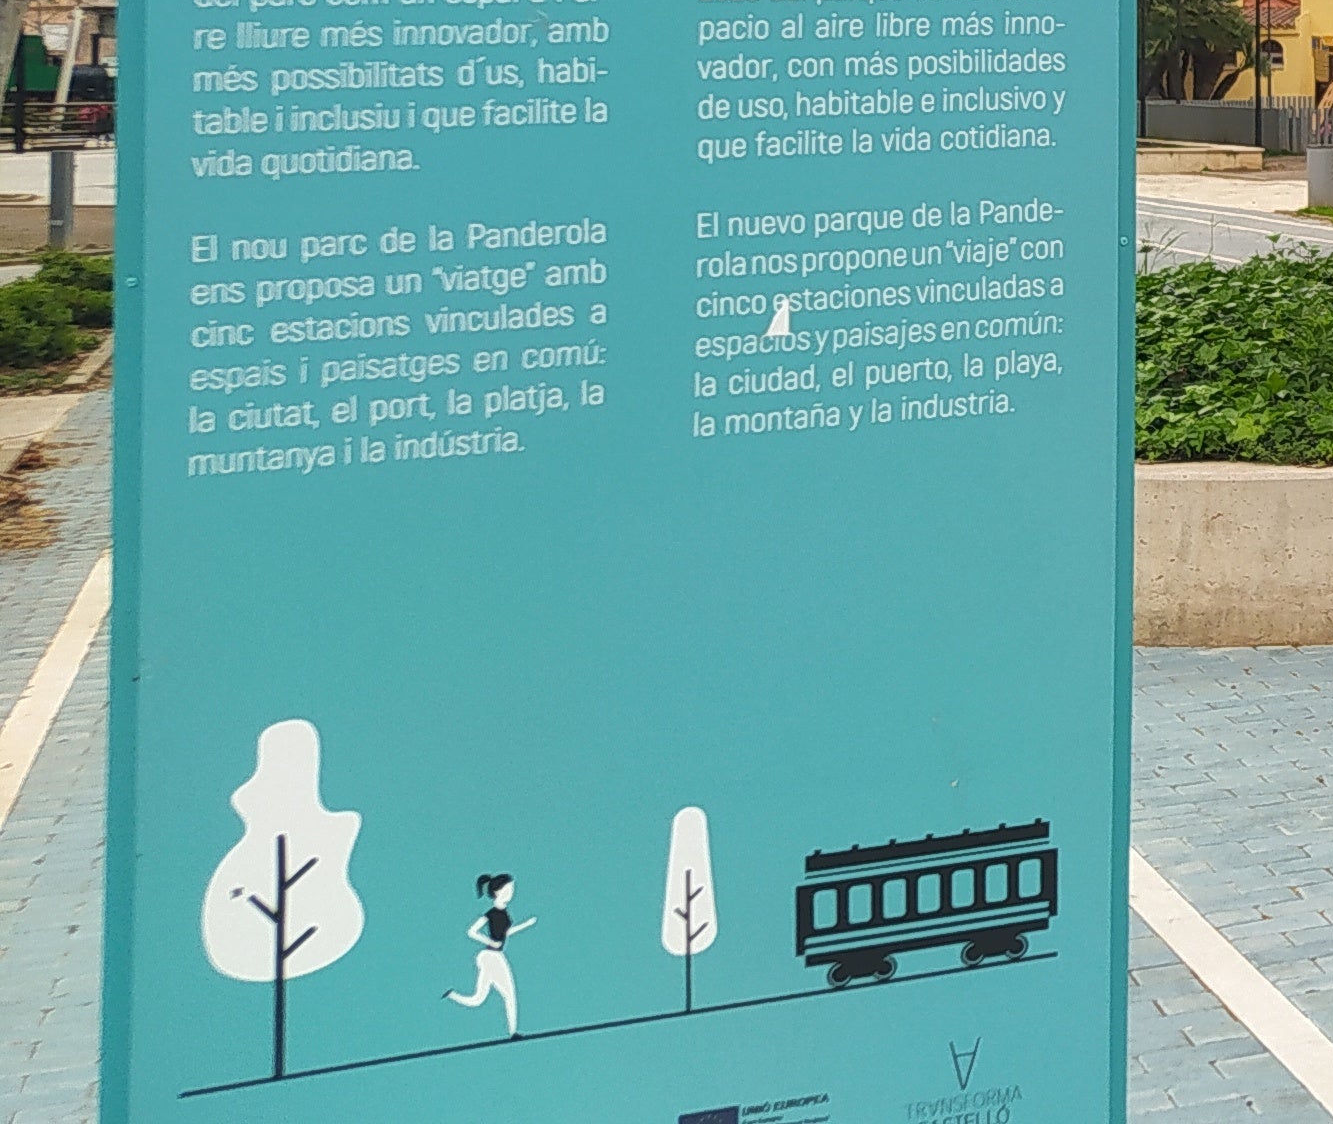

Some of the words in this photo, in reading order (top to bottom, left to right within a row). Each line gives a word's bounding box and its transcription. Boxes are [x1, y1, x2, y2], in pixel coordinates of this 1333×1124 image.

[699, 13, 770, 46] pacio
[781, 12, 803, 39] al
[814, 12, 864, 39] aire
[875, 11, 931, 38] libre
[941, 10, 994, 36] más
[1004, 10, 1066, 35] inno-
